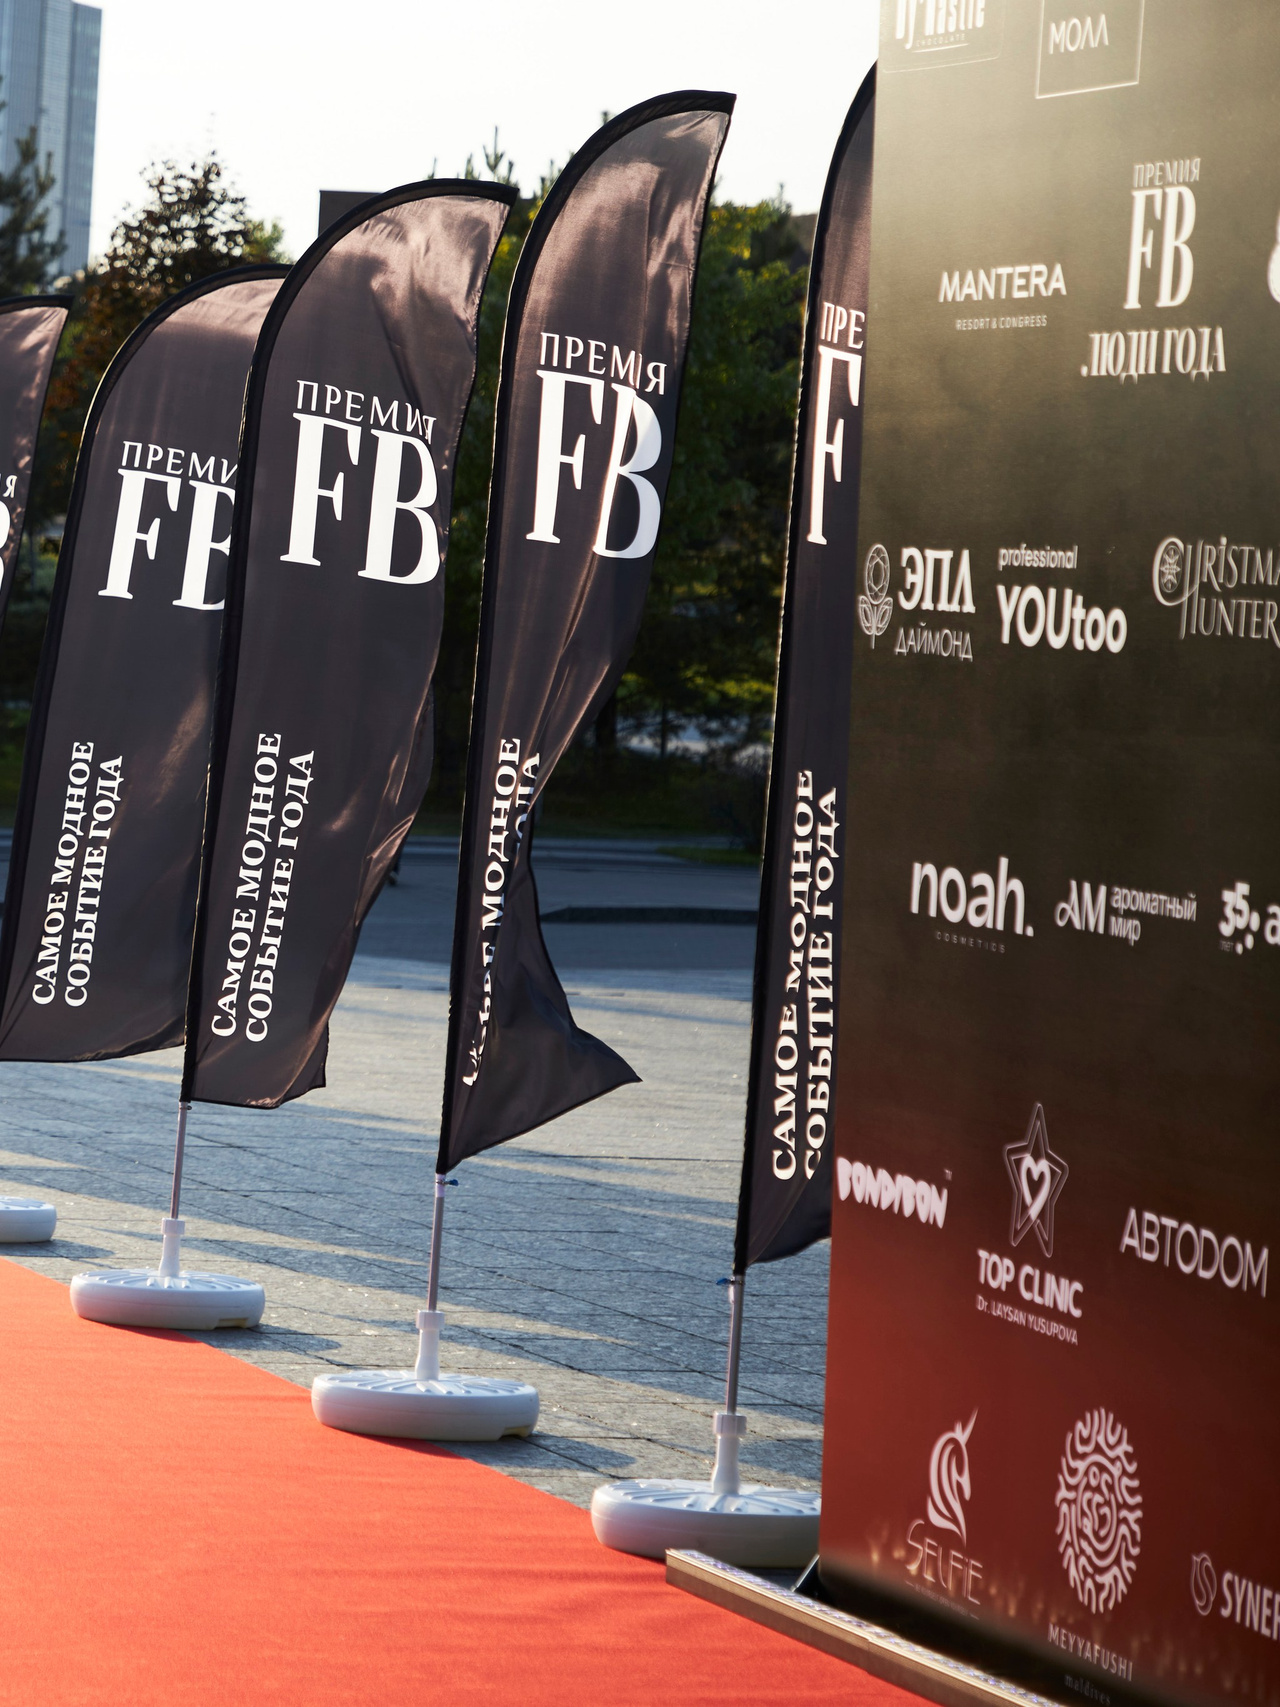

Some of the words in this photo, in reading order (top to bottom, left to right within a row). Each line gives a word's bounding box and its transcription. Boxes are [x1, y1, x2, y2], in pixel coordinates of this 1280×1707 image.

[1133, 158, 1201, 187] ПРЕМИЯ
[1123, 185, 1196, 309] FB
[939, 263, 1067, 302] MANTERA
[956, 318, 990, 331] RESORT
[999, 315, 1048, 329] CONGRESS
[1162, 326, 1226, 382] ГОДА
[279, 412, 440, 585] FB
[526, 370, 662, 559] FB
[999, 543, 1078, 571] professional
[895, 621, 973, 662] ДАЙМОНД
[996, 585, 1127, 653] YOUtoo
[50, 741, 94, 885] МОДНОЕ
[481, 738, 521, 931] МОДНОЕ
[64, 845, 108, 1007] СОБЫТИЕ
[88, 755, 124, 839] ГОДА
[211, 908, 257, 1037] САМОЕ
[235, 733, 282, 901] МОДНОЕ
[814, 787, 840, 921] ГОДА
[245, 858, 294, 1042] СОБЫТИЕ
[278, 750, 314, 850] ГОДА
[1111, 886, 1197, 921] ароматный
[32, 891, 69, 1005] САМОЕ
[936, 932, 1006, 953] COSMETICS
[1110, 916, 1141, 946] мир
[772, 1003, 798, 1181] САМОЕ
[786, 770, 814, 993] МОДНОЕ
[977, 1248, 1015, 1292] TOP
[1018, 1264, 1083, 1318] CLINIC
[991, 1301, 1026, 1328] LAYSAN
[1027, 1313, 1079, 1345] YUSUPOVA
[1048, 1622, 1133, 1681] MEYYAFUSHI
